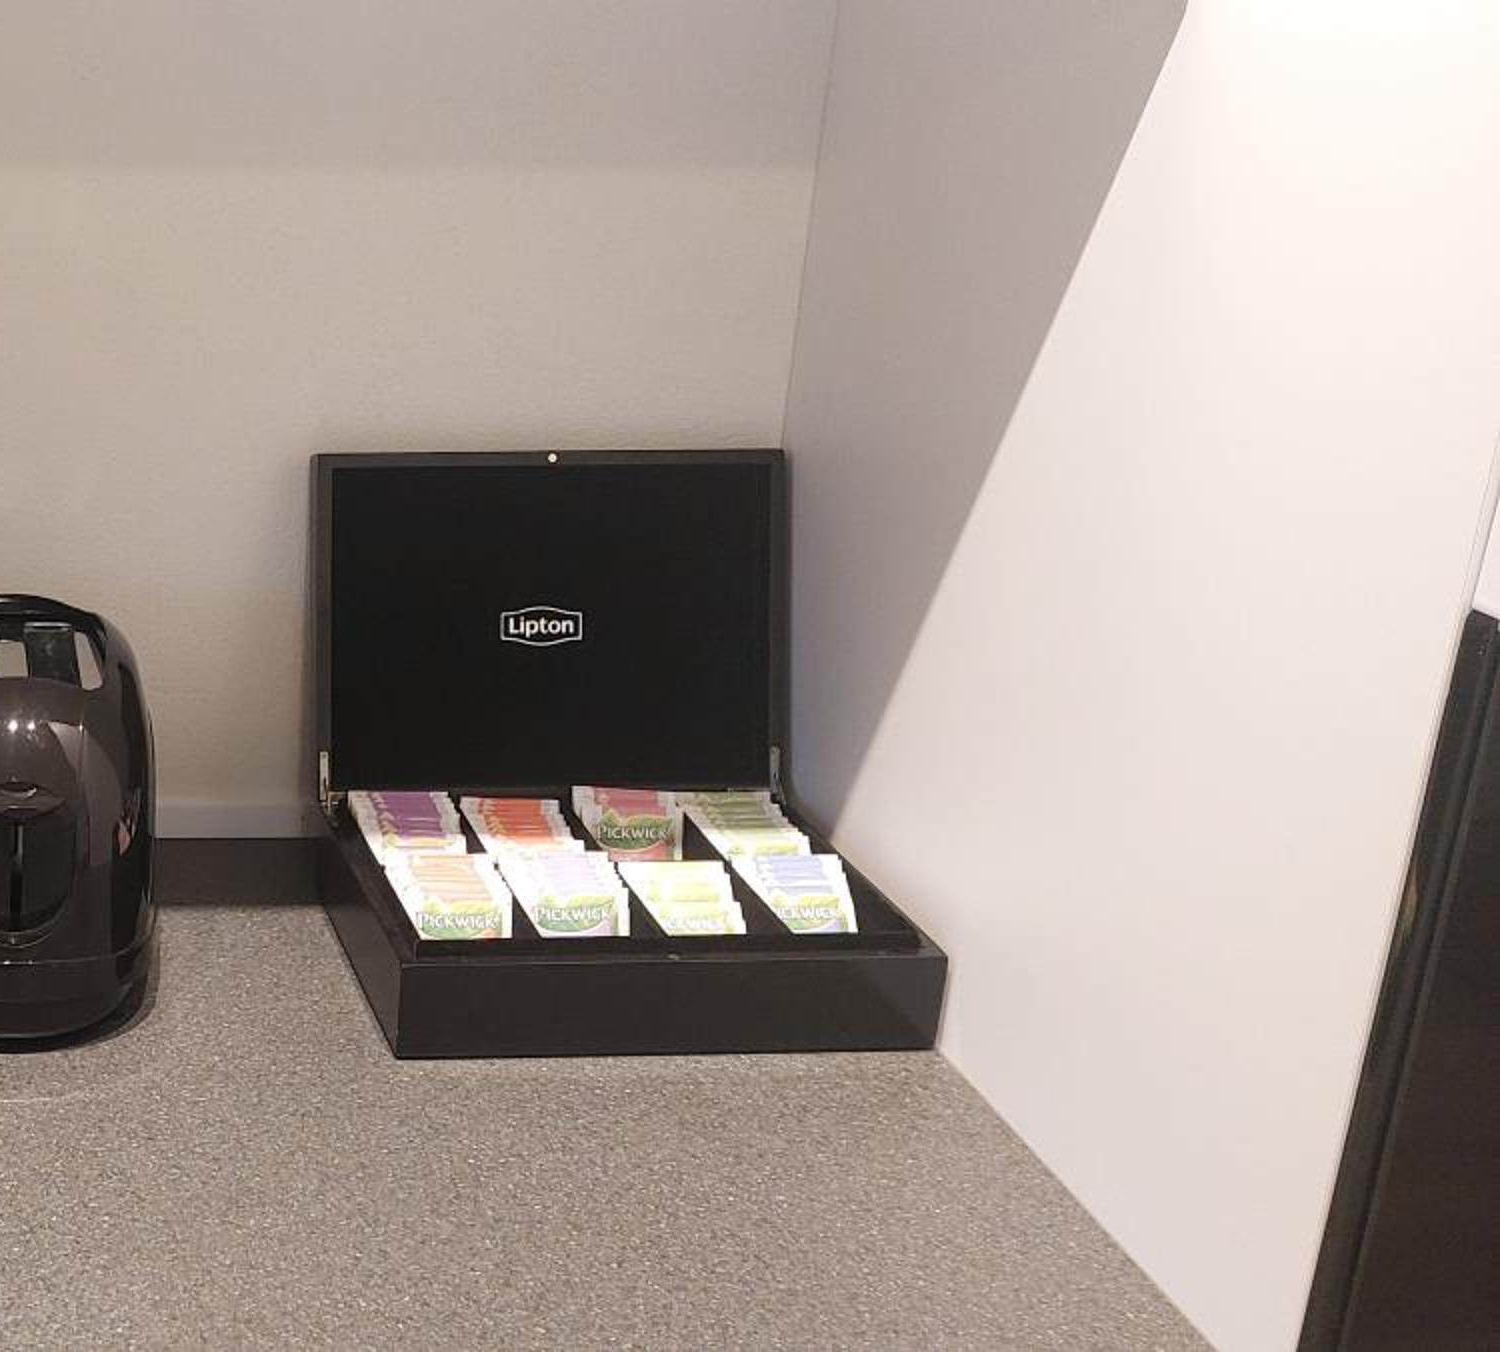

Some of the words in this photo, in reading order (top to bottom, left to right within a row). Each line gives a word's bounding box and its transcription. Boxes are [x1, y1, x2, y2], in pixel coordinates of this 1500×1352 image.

[508, 616, 575, 638] Lipton
[597, 822, 668, 841] PICKWICK
[419, 912, 499, 929] PICKWICK
